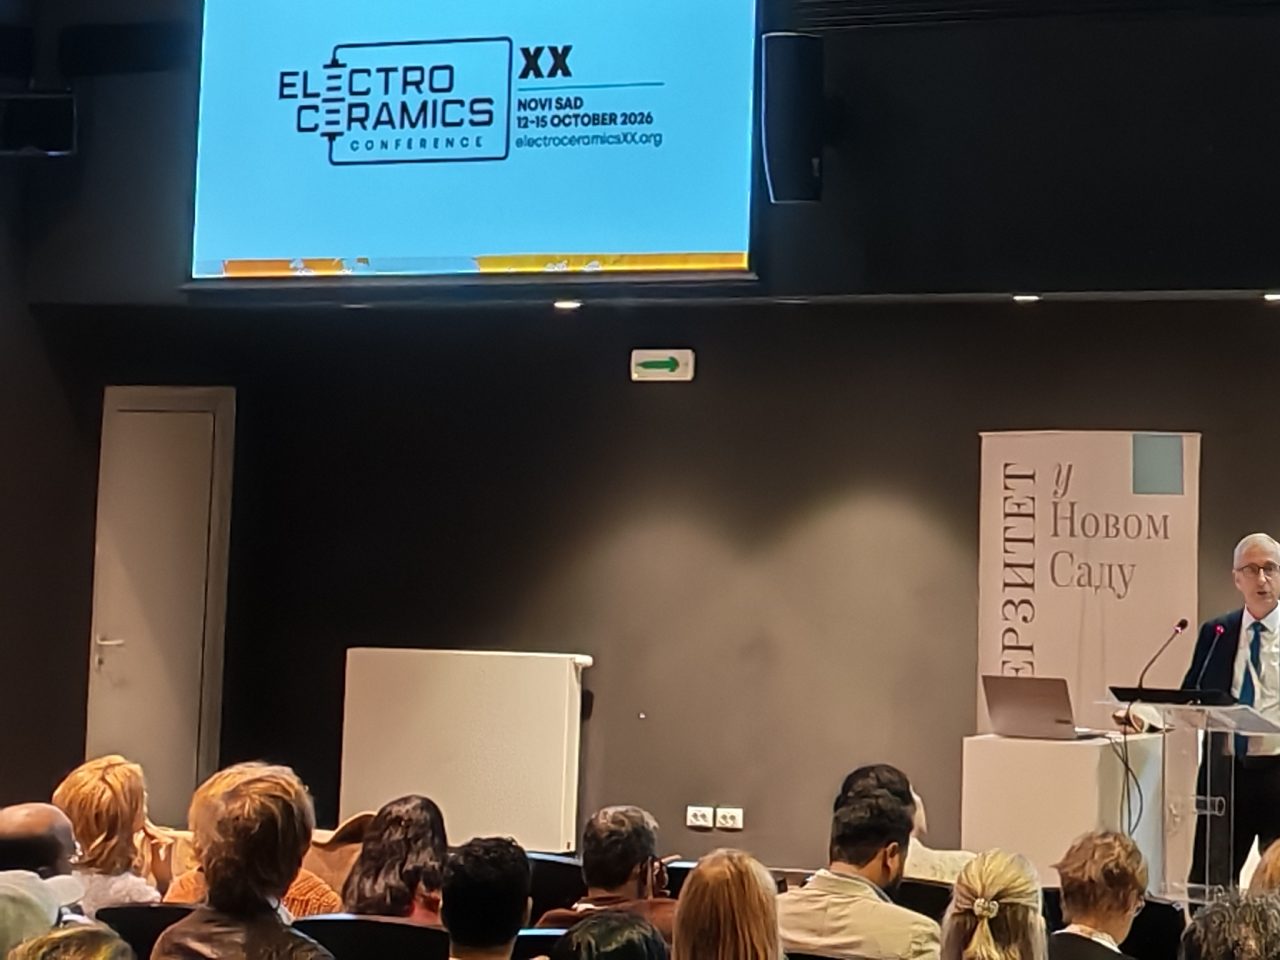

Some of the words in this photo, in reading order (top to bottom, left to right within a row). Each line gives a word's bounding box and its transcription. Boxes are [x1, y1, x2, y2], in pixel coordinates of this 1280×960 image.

[518, 45, 573, 79] XX
[279, 64, 455, 100] ELECTRO
[517, 97, 552, 112] NOVI
[554, 96, 584, 110] SAD
[297, 98, 494, 136] CERAMICS
[517, 115, 548, 128] 12-15
[550, 113, 618, 127] OCTOBER
[620, 112, 654, 125] 2026
[350, 136, 483, 151] CONFERENCE
[515, 132, 663, 148] electroceramicsXX.org
[1049, 550, 1136, 600] Саду
